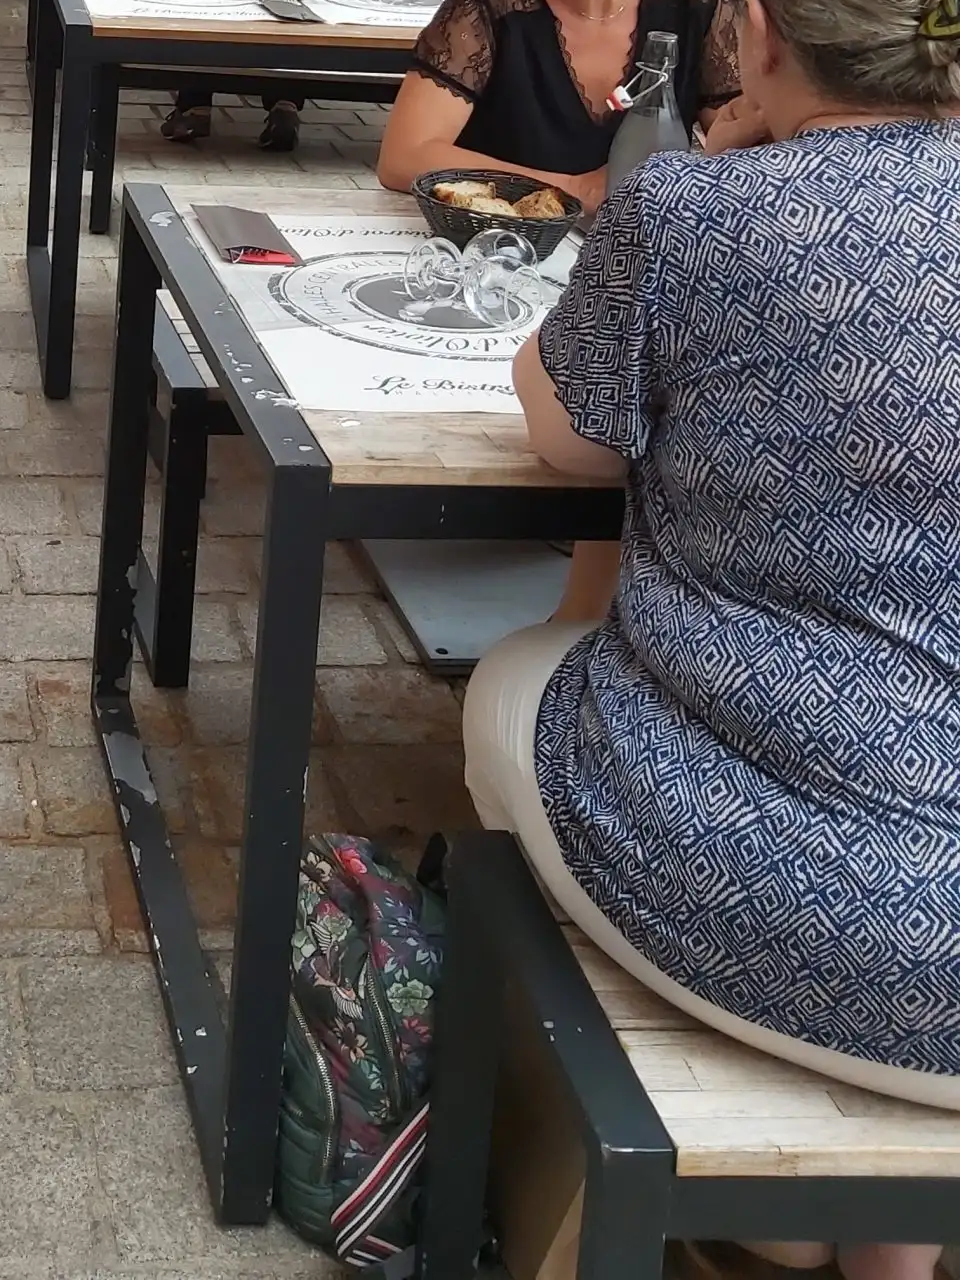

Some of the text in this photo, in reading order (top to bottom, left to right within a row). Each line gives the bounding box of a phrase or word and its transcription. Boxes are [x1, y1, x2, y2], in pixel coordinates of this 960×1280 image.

[303, 284, 343, 315] HALLES
[362, 324, 499, 352] d'Olivier
[363, 374, 416, 395] Le
